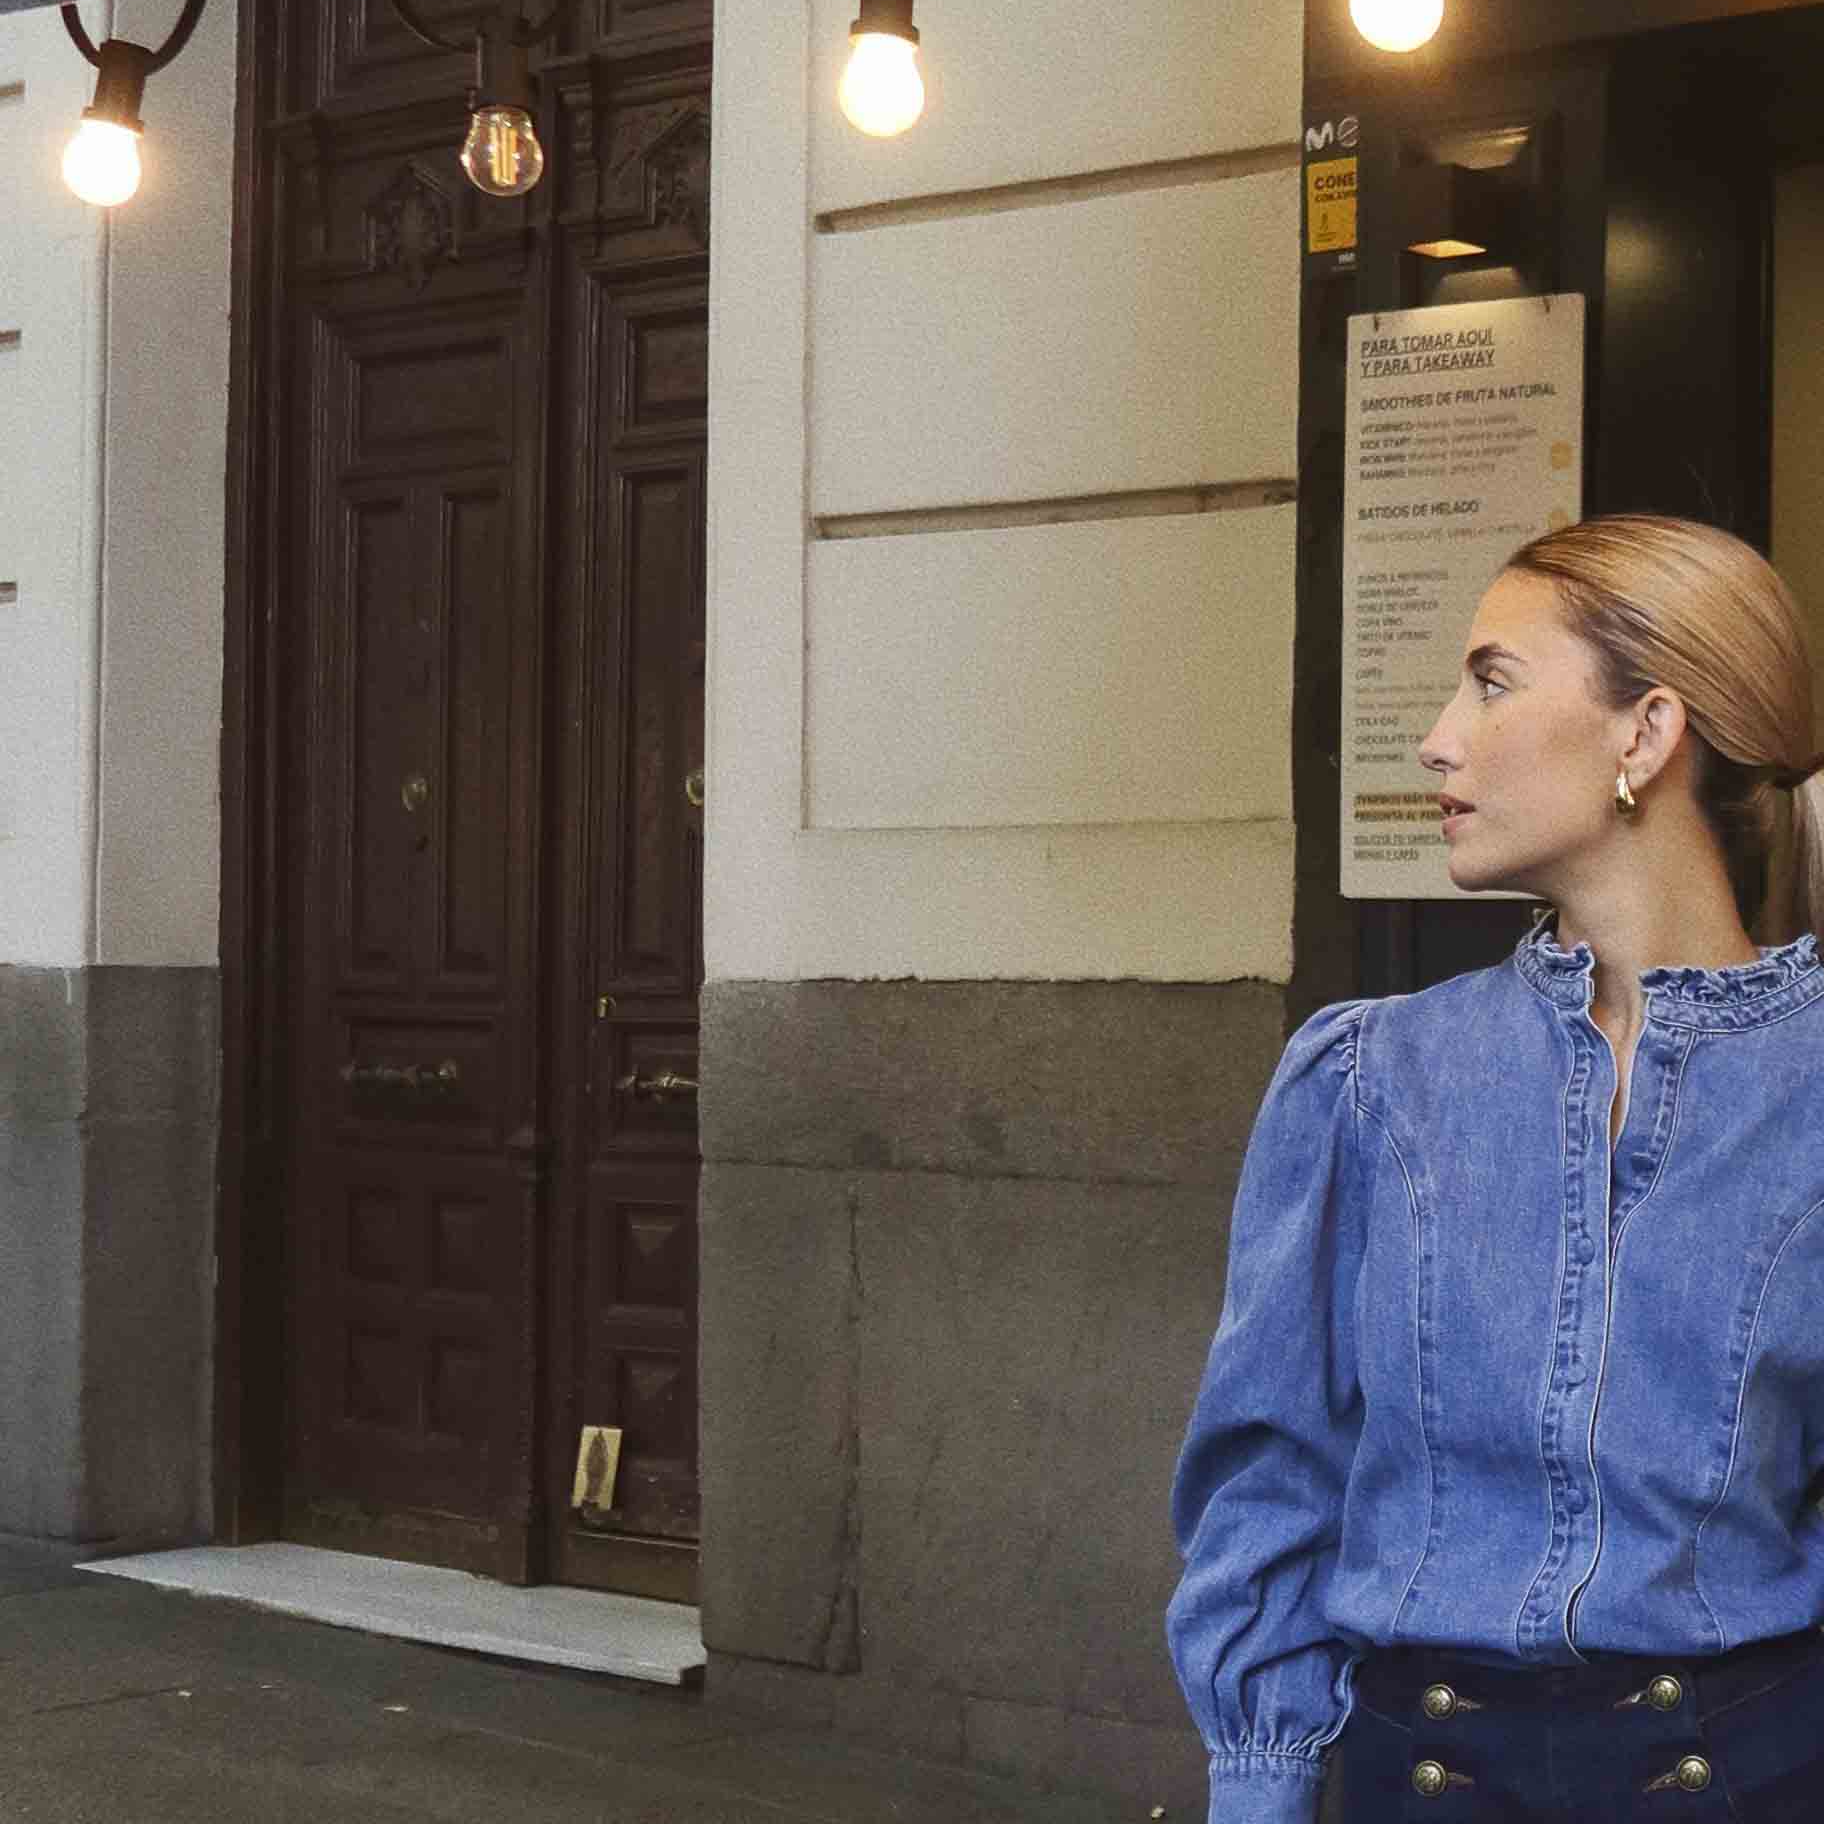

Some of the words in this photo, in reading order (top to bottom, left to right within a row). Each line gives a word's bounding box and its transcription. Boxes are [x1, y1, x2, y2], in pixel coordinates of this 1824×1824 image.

[1360, 336, 1398, 356] PARA
[1402, 332, 1453, 352] TOMAR
[1373, 357, 1410, 375] PARA
[1415, 350, 1496, 371] TAKEAWAY
[1359, 393, 1433, 412] SMOOTHIES
